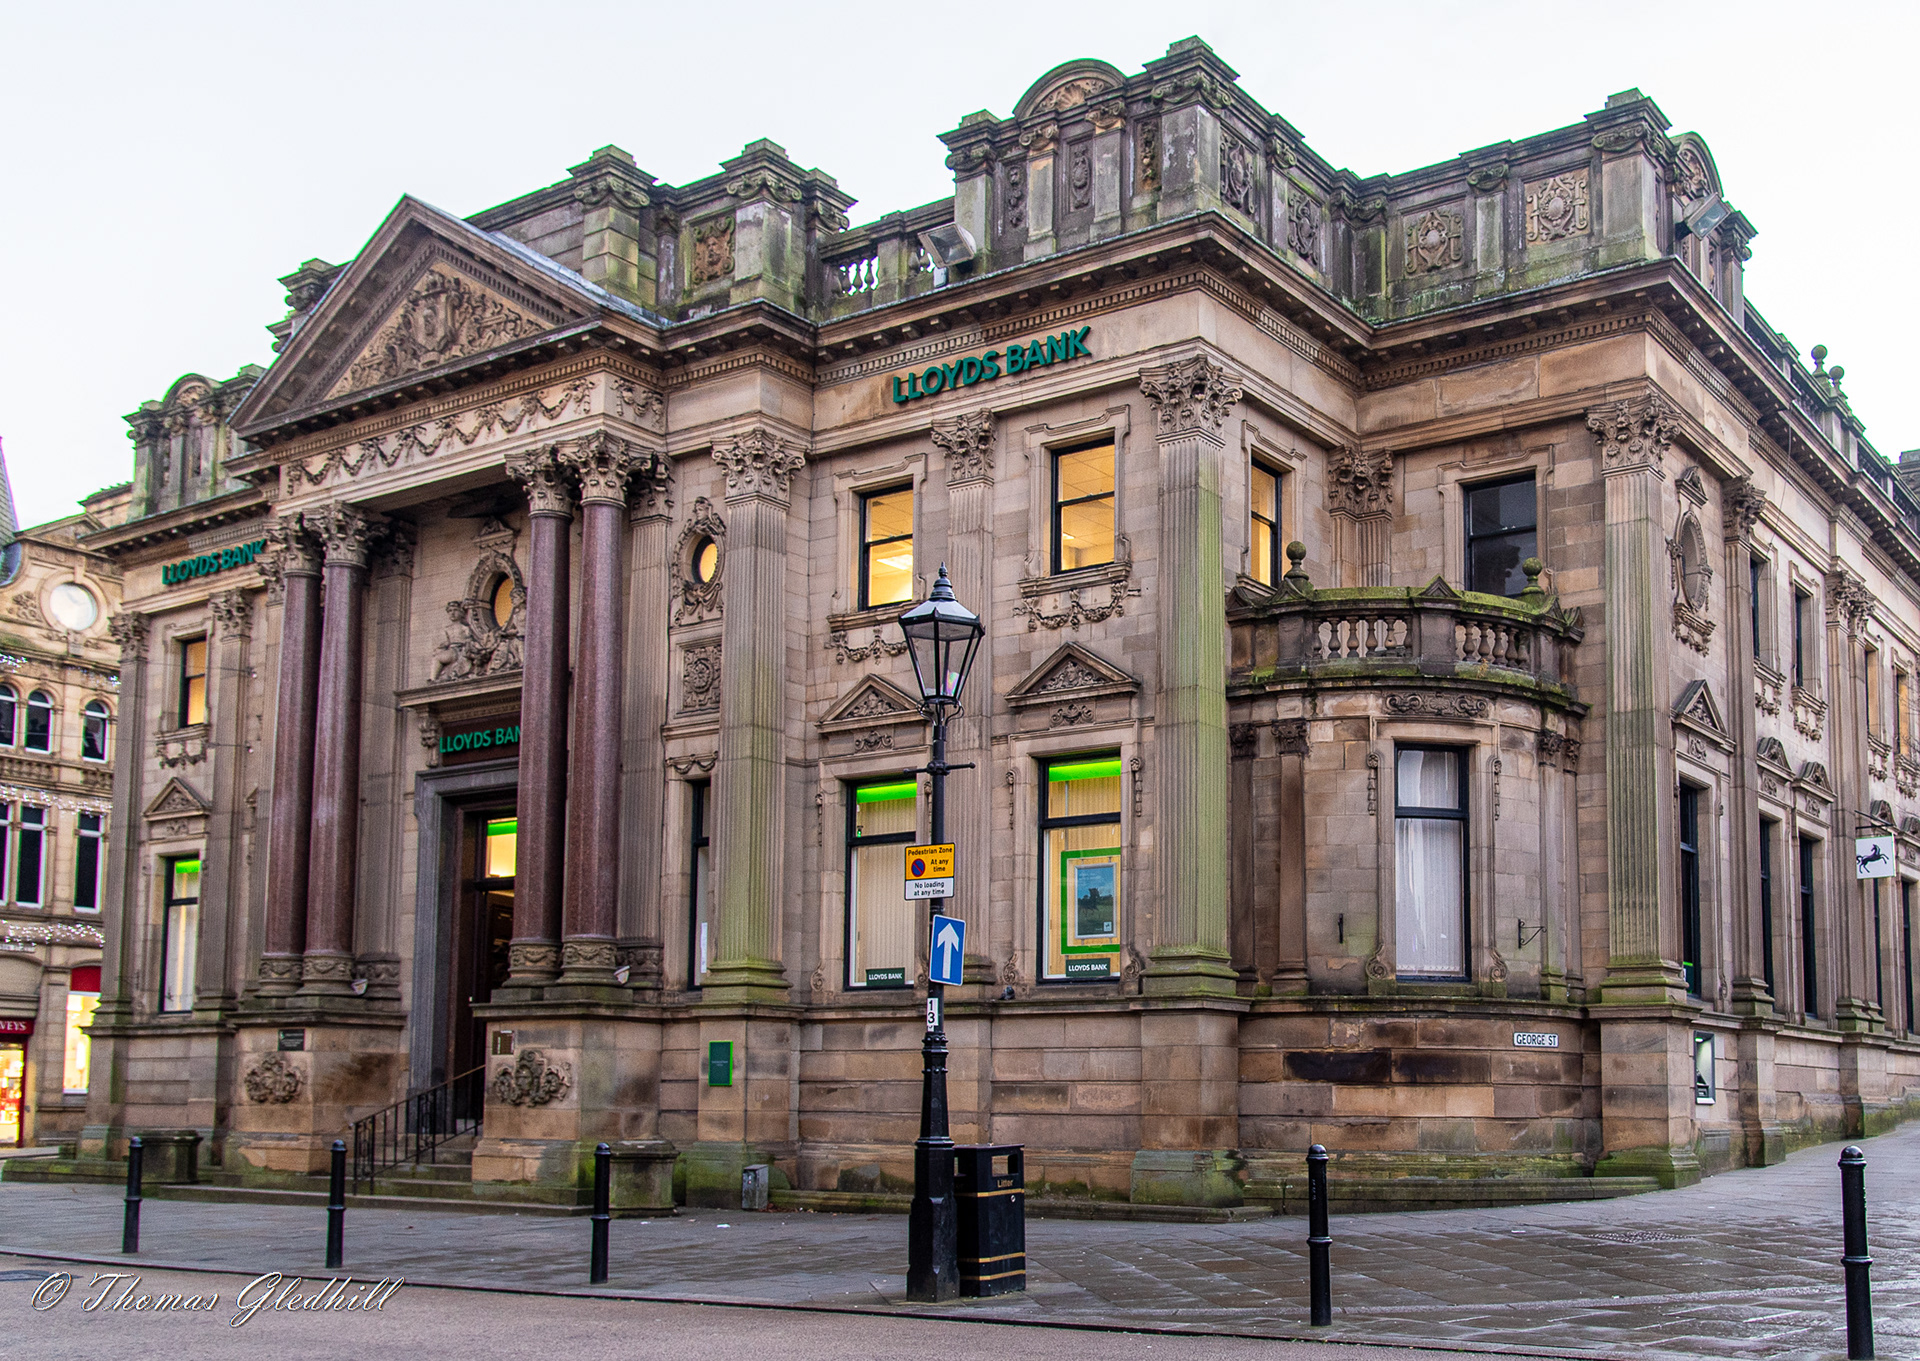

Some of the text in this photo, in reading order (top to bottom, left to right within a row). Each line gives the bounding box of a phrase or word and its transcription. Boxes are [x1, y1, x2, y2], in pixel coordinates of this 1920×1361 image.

[893, 326, 1091, 403] LLOYDS BANK
[162, 539, 266, 585] LLOYDS BANK
[439, 729, 491, 753] LLOYDS
[908, 848, 937, 856] Pedestrian
[1068, 963, 1107, 972] LLOYDS BANK
[1516, 1034, 1556, 1045] GEORGE ST
[997, 1179, 1014, 1188] Litter
